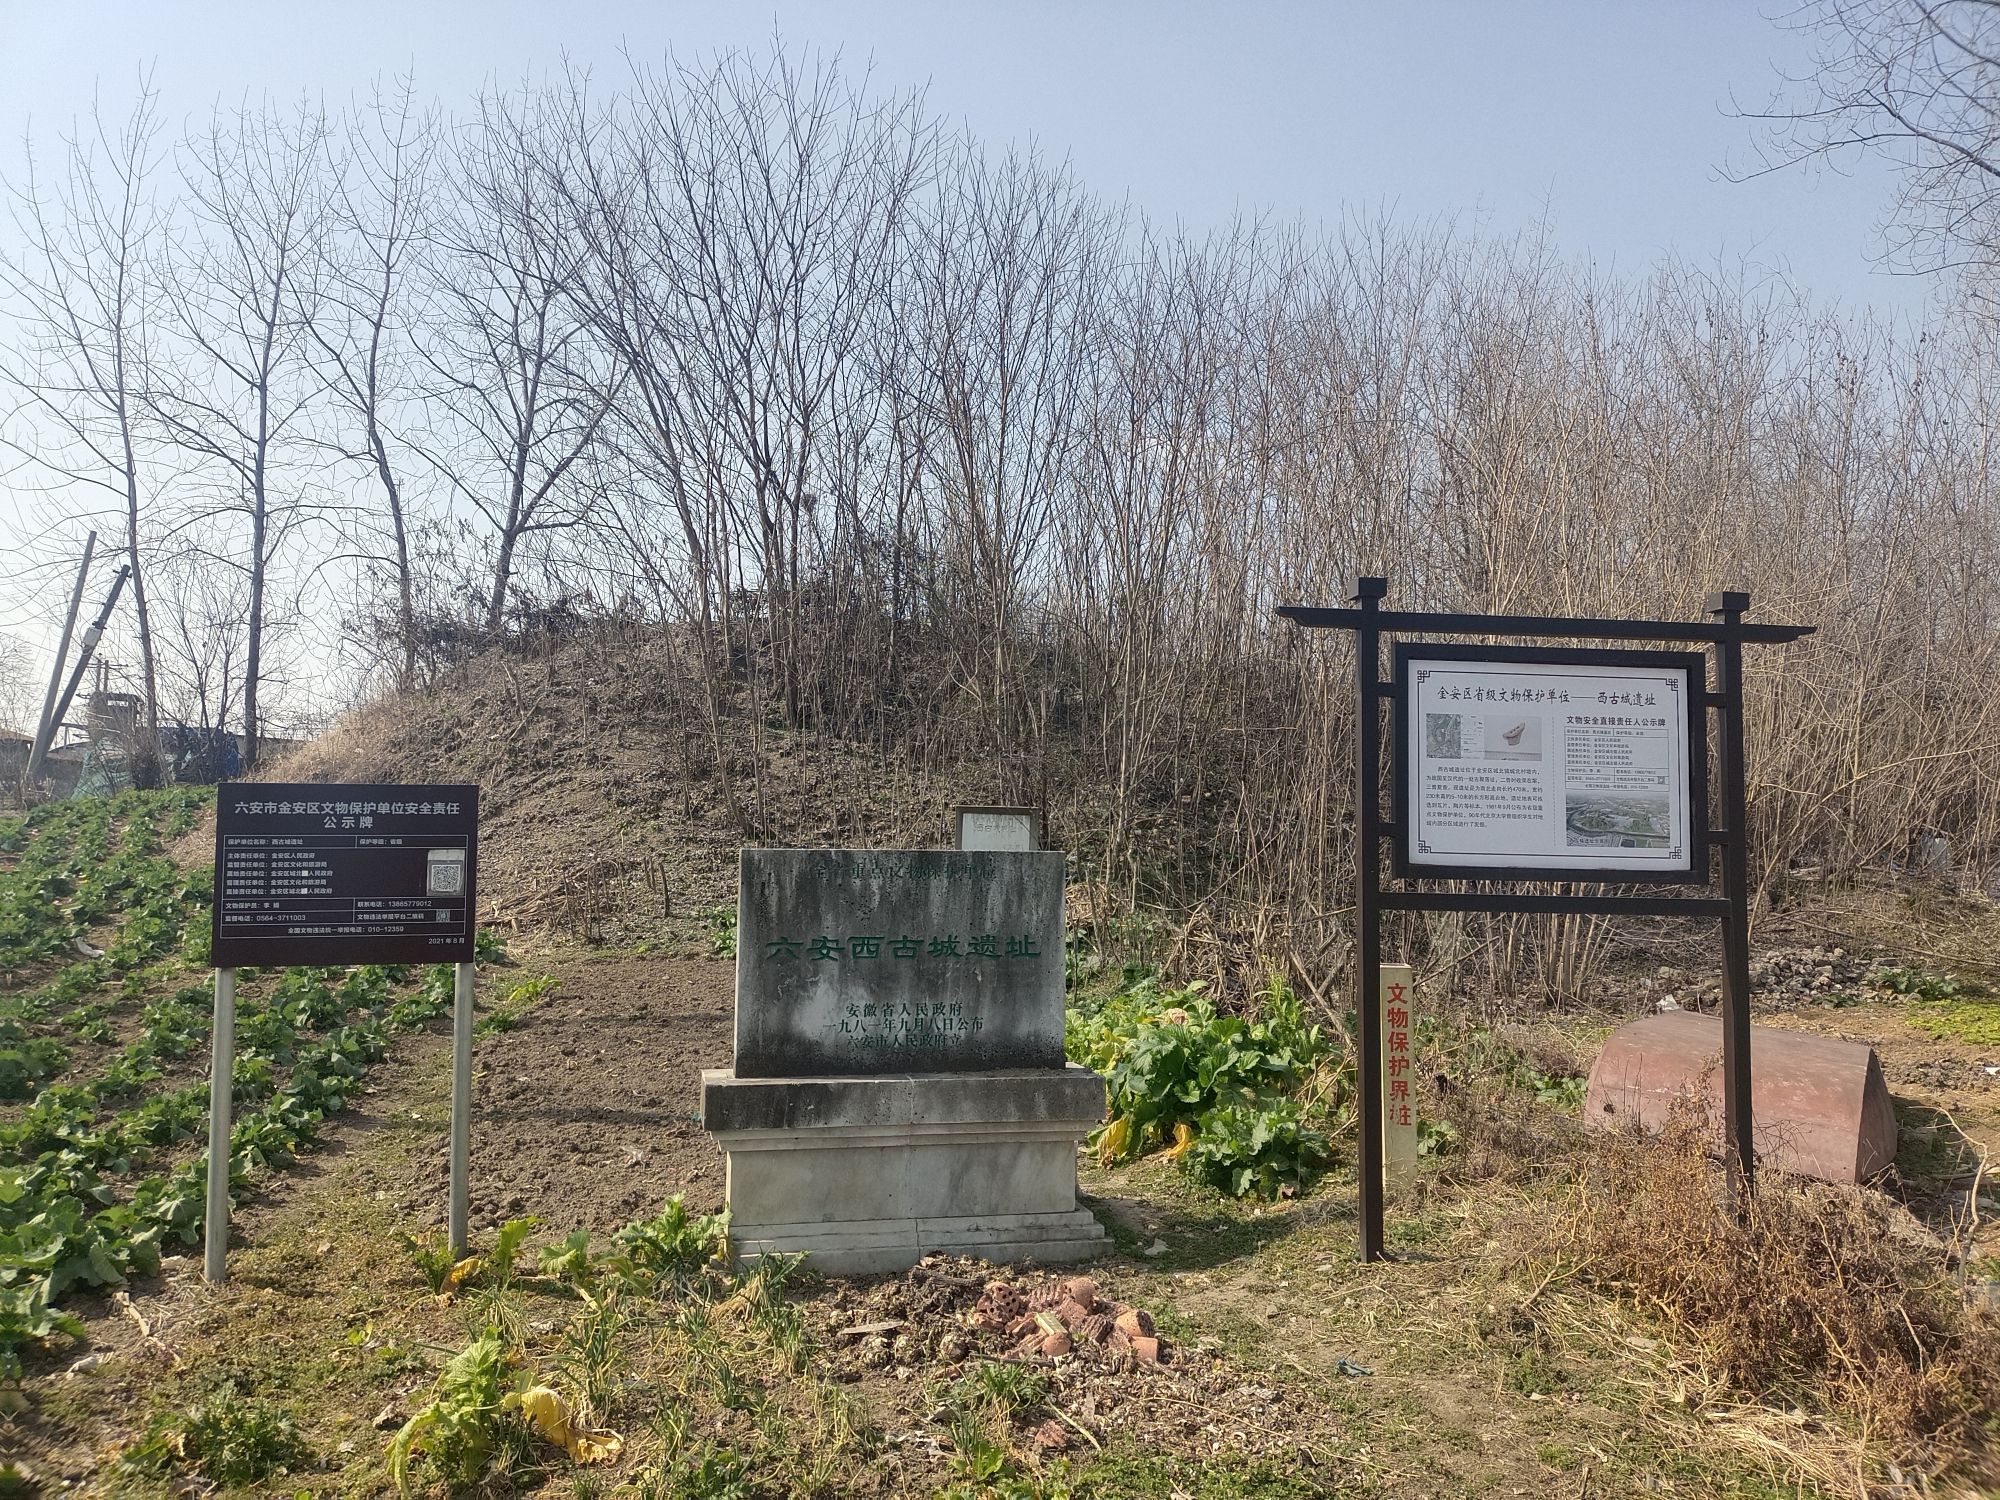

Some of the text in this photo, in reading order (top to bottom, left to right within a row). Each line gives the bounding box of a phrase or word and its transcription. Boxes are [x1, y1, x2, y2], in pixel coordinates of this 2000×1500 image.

[1566, 715, 1666, 727] 文物安全直接责任人公示牌
[234, 801, 461, 816] 六安市金安区文物保护单位安全责任
[323, 816, 374, 829] 公示牌
[765, 934, 1042, 962] 六安西古城遗址
[846, 1001, 964, 1019] 安徽省人民政府
[822, 1015, 984, 1035] 一九八一年九月八日公布
[846, 1033, 963, 1049] 六安市人民政府立
[1386, 982, 1412, 1126] 文物保护界桩
